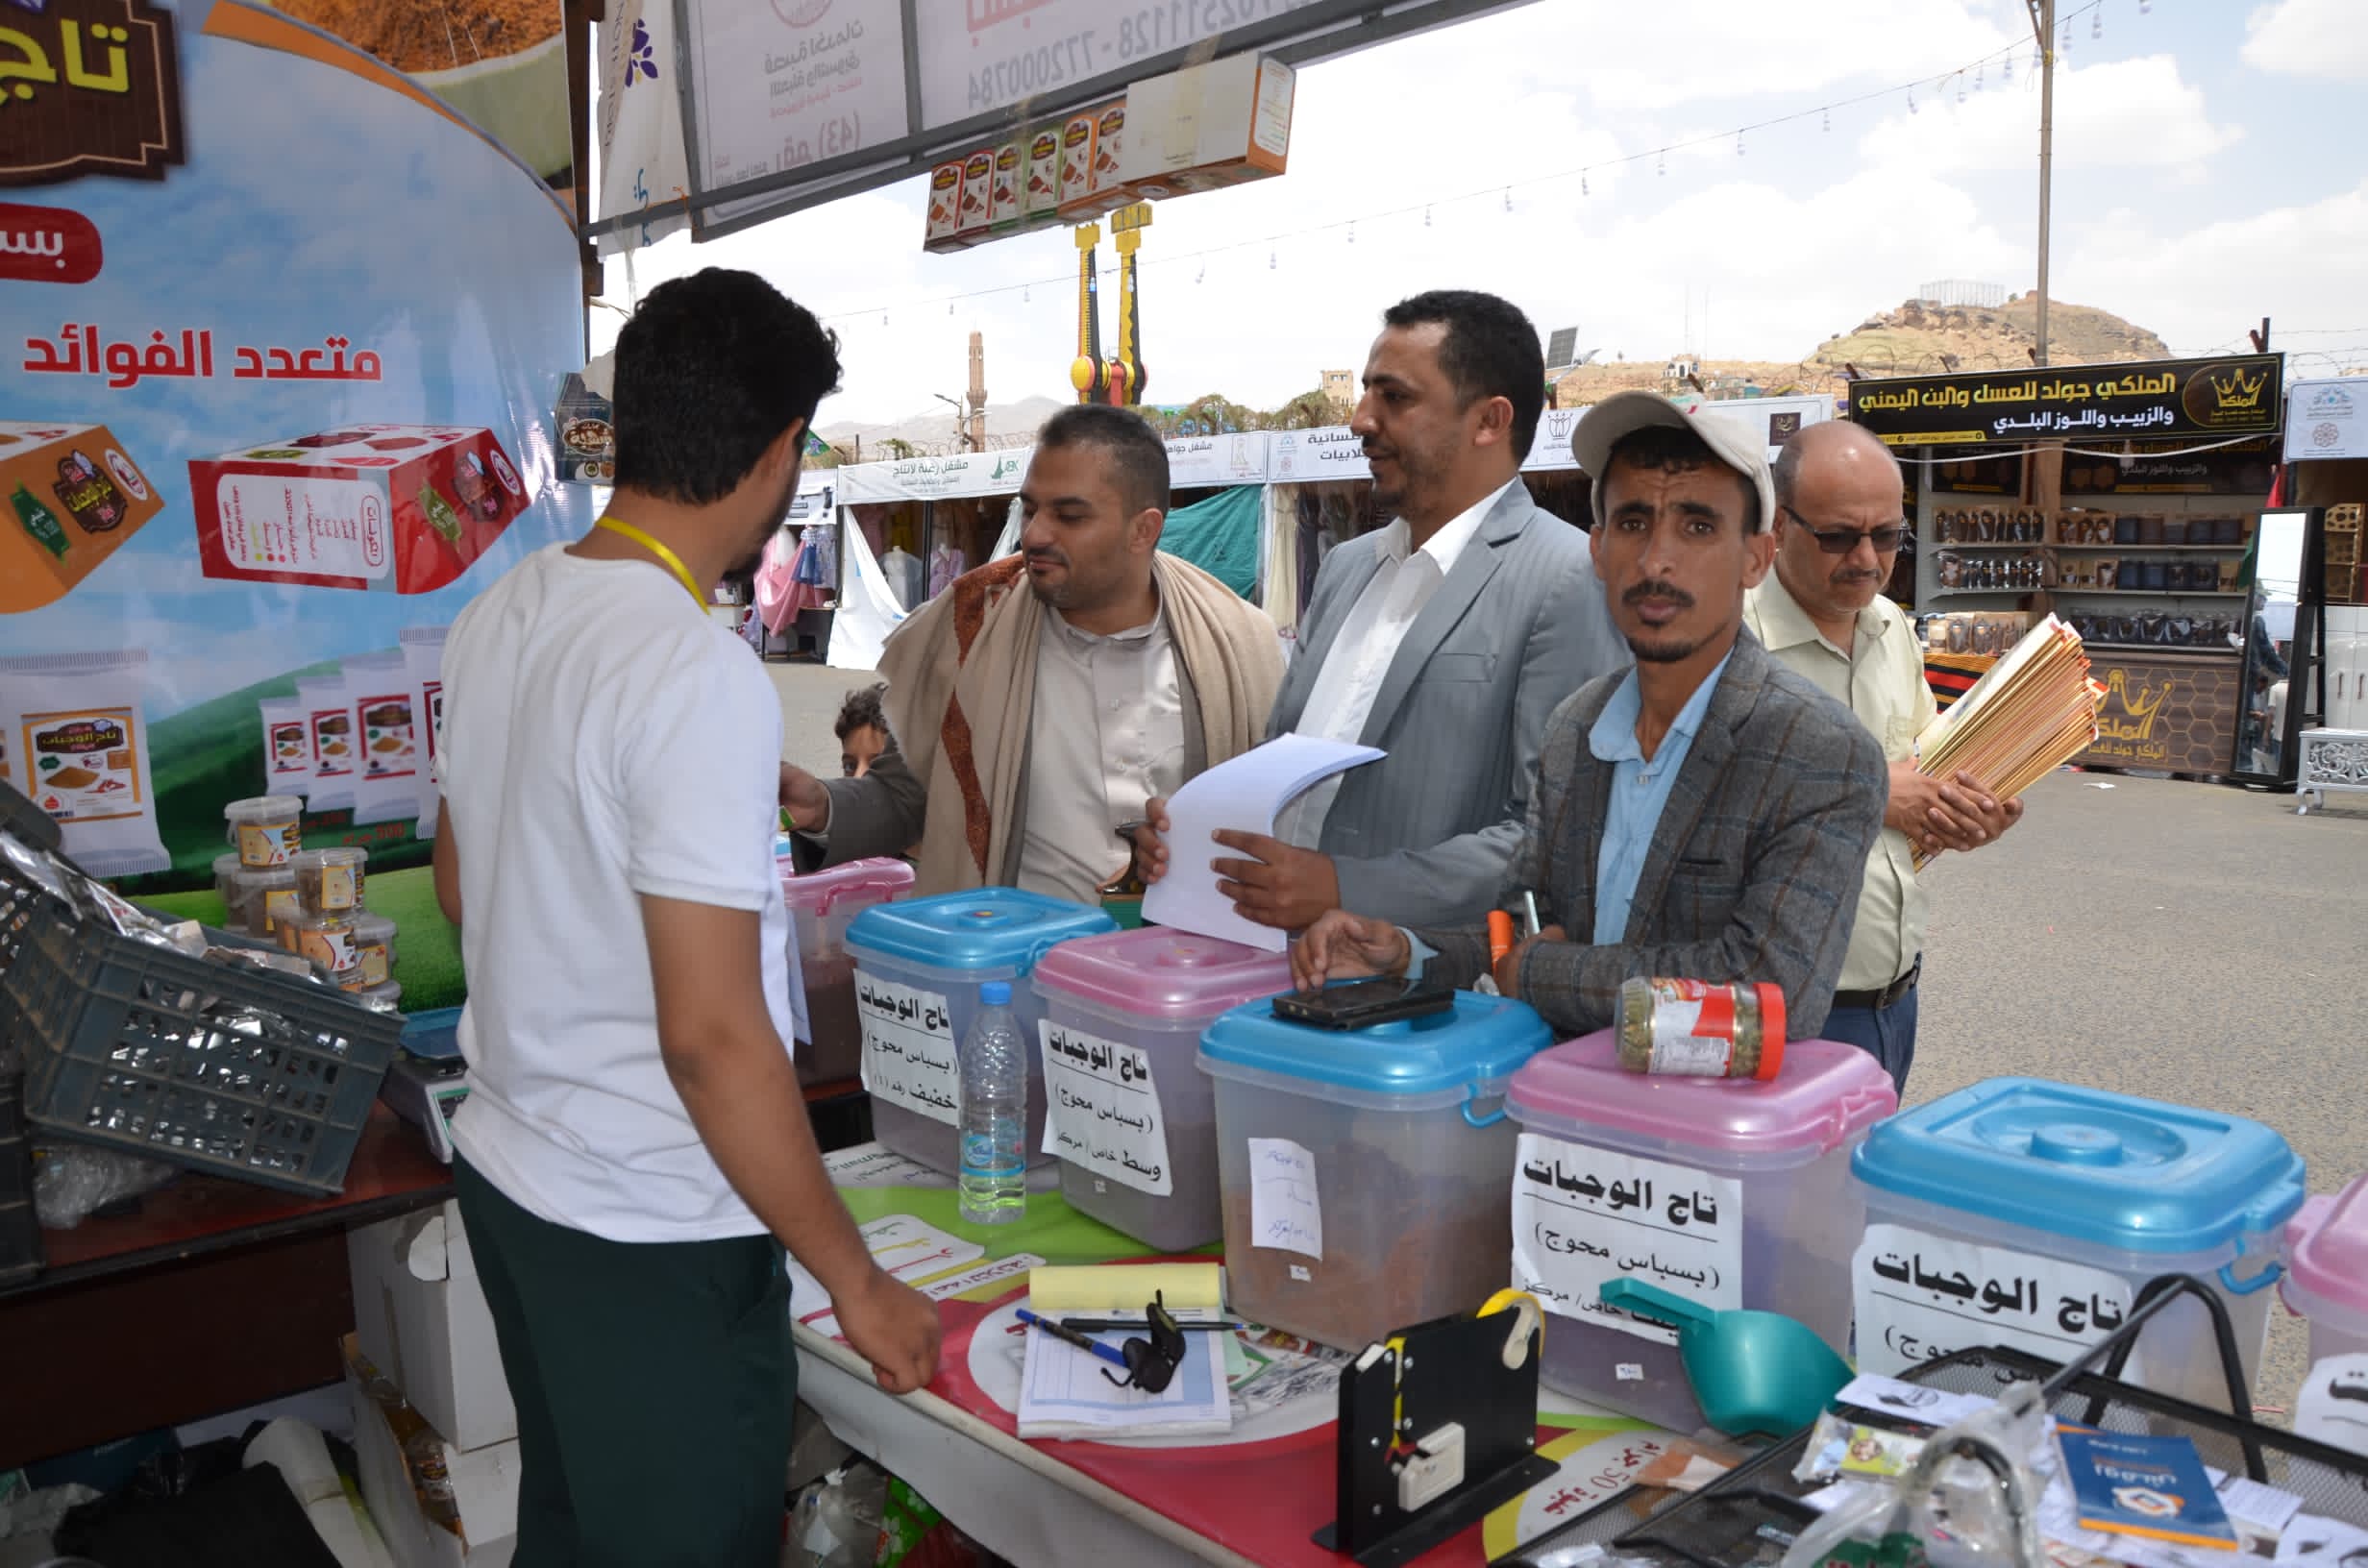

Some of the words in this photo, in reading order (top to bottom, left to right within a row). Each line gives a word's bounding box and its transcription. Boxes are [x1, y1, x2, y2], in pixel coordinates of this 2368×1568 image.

[24, 323, 213, 388] الفوائد
[234, 334, 382, 382] متعدد
[1858, 388, 1919, 413] اليمني
[1921, 385, 1970, 410] والبن
[1973, 380, 2037, 404] للعسل
[2040, 380, 2091, 404] جولد
[2095, 372, 2177, 402] الملكي
[1992, 411, 2052, 434] البلدي
[2053, 408, 2108, 429] واللوز
[2109, 405, 2175, 429] والزبيب
[1166, 444, 1187, 455] جواه
[941, 459, 969, 474] مشغل
[859, 983, 920, 1021] الوجبات
[1048, 1029, 1113, 1071] الوجبات
[909, 1082, 958, 1110] خفيف
[1097, 1106, 1154, 1135] (بسباس
[1122, 1149, 1162, 1183] وسط
[1522, 1159, 1653, 1212] الوجبات
[1667, 1190, 1718, 1226] تاج
[1535, 1221, 1611, 1259] محوج)
[1616, 1252, 1721, 1291] (بسباس
[1871, 1252, 2038, 1314] الوجبات
[1521, 1278, 1570, 1301] مركز
[2057, 1292, 2123, 1334] تاج
